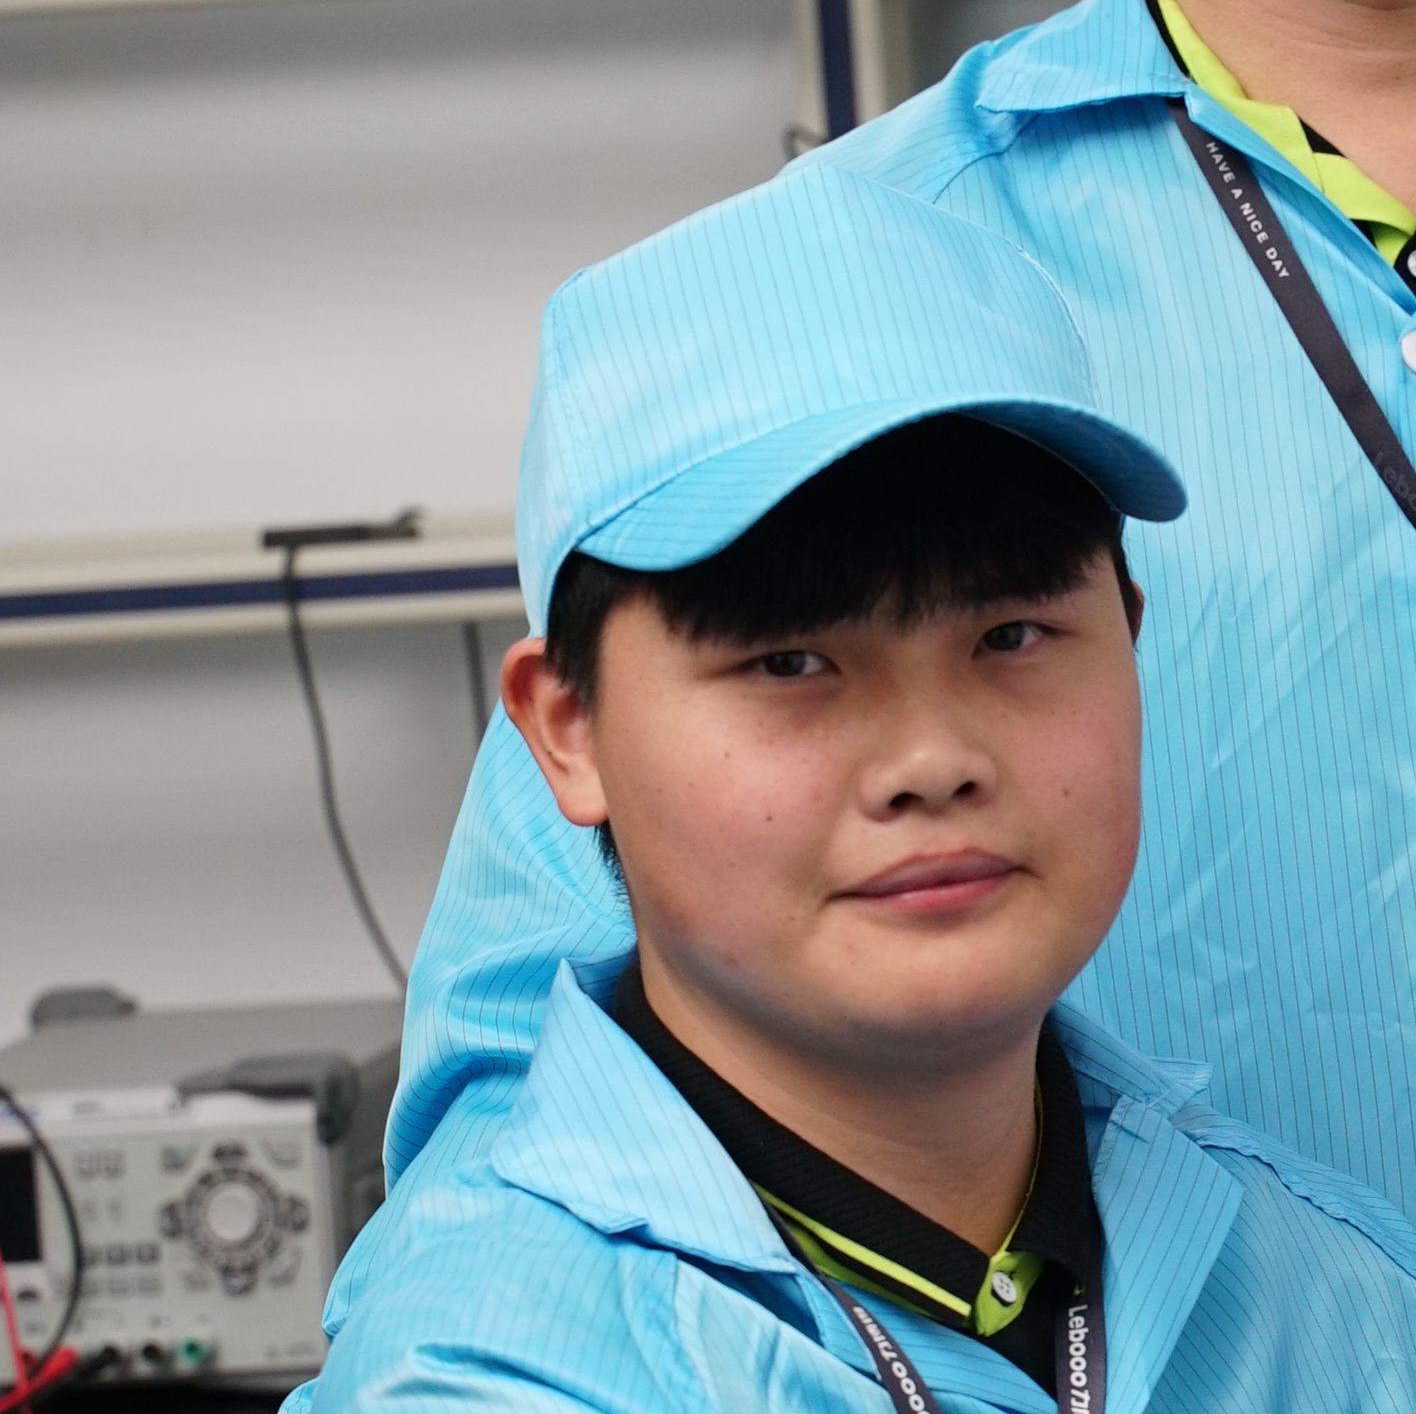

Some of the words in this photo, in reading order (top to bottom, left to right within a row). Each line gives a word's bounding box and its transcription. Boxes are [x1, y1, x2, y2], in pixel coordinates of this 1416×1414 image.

[1206, 142, 1236, 183] HAVE
[1231, 188, 1243, 200] A
[1240, 202, 1269, 243] NICE
[1265, 247, 1290, 278] DAY
